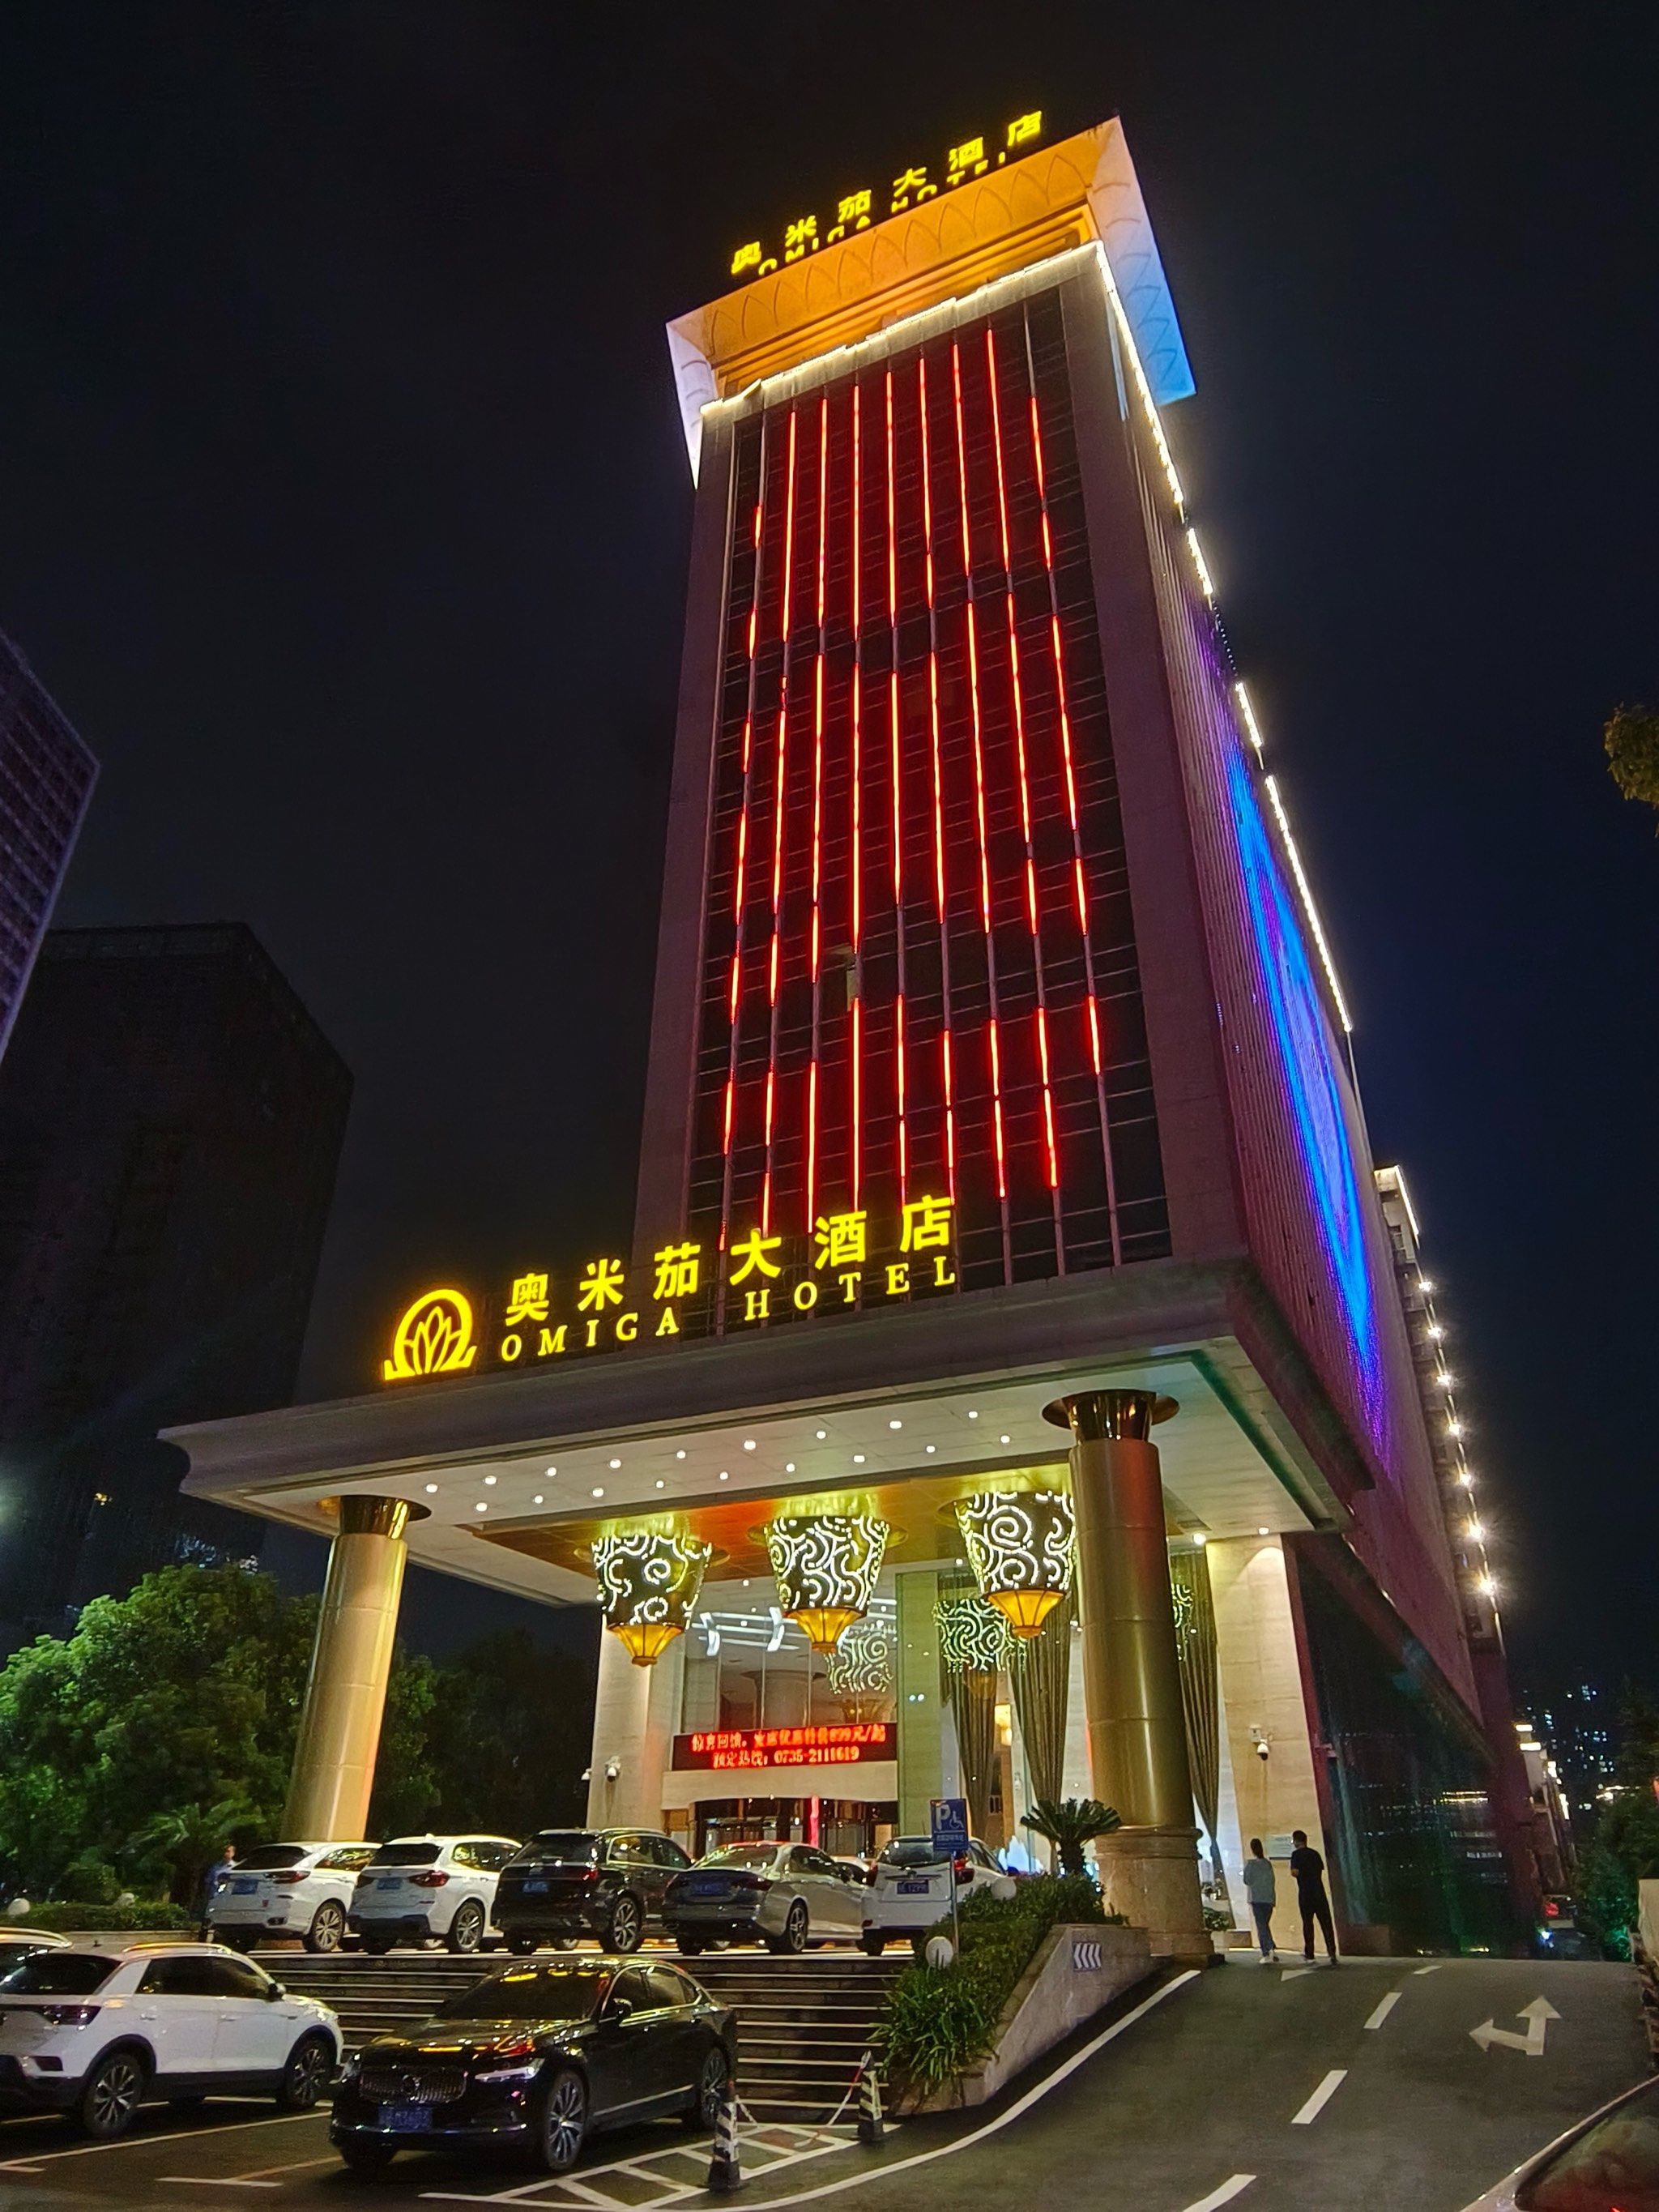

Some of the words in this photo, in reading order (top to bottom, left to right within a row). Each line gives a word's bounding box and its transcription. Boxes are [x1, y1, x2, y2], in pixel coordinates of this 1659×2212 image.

[731, 110, 1043, 274] 奥米茄大酒店
[501, 1306, 680, 1362] OMIGA
[744, 1256, 956, 1322] HOTEL
[504, 1194, 955, 1326] 奥米茄大酒店
